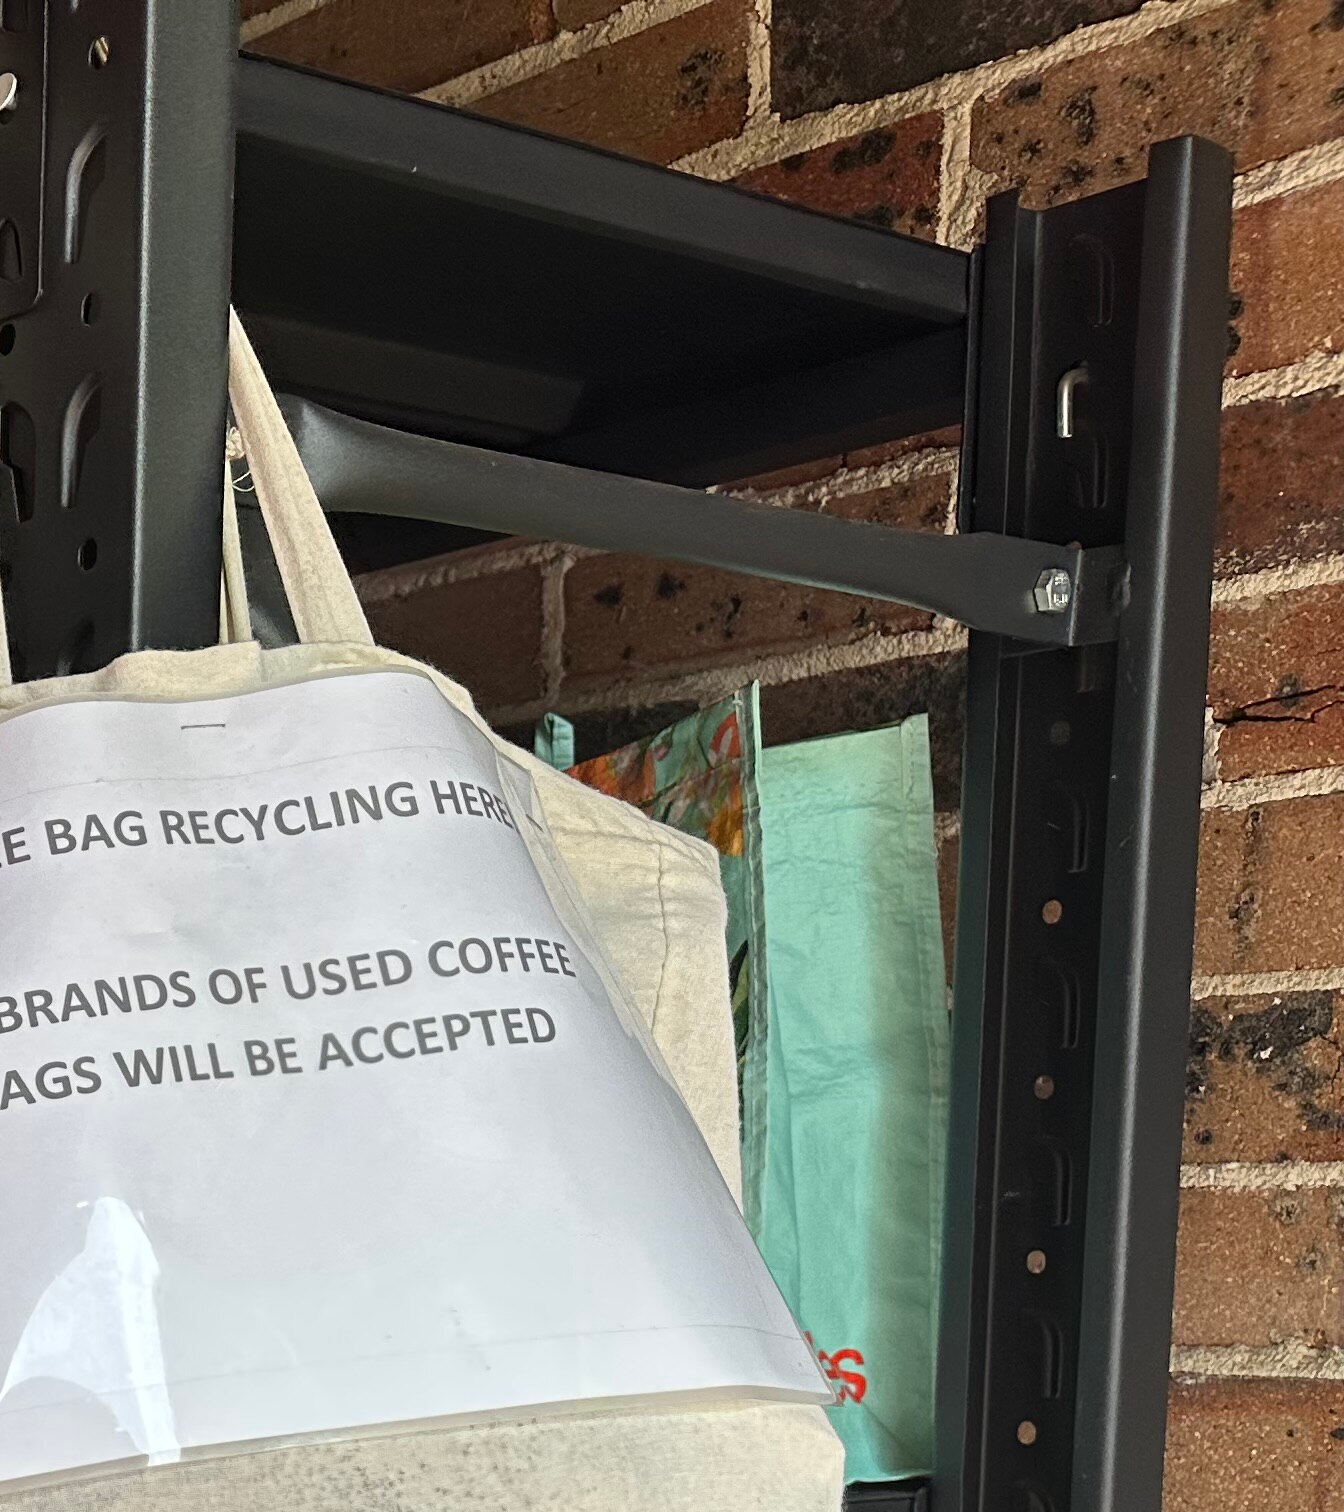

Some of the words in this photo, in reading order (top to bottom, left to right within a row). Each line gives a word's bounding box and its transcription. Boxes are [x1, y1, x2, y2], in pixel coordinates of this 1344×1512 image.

[44, 809, 148, 857] BAG
[163, 781, 421, 847] RECYCLING
[208, 966, 267, 1006] OF
[280, 947, 413, 1002] USED
[427, 936, 576, 979] COFFEE
[113, 1041, 234, 1089] WILL
[245, 1037, 303, 1079] BE
[317, 1006, 557, 1072] ACCEPTED
